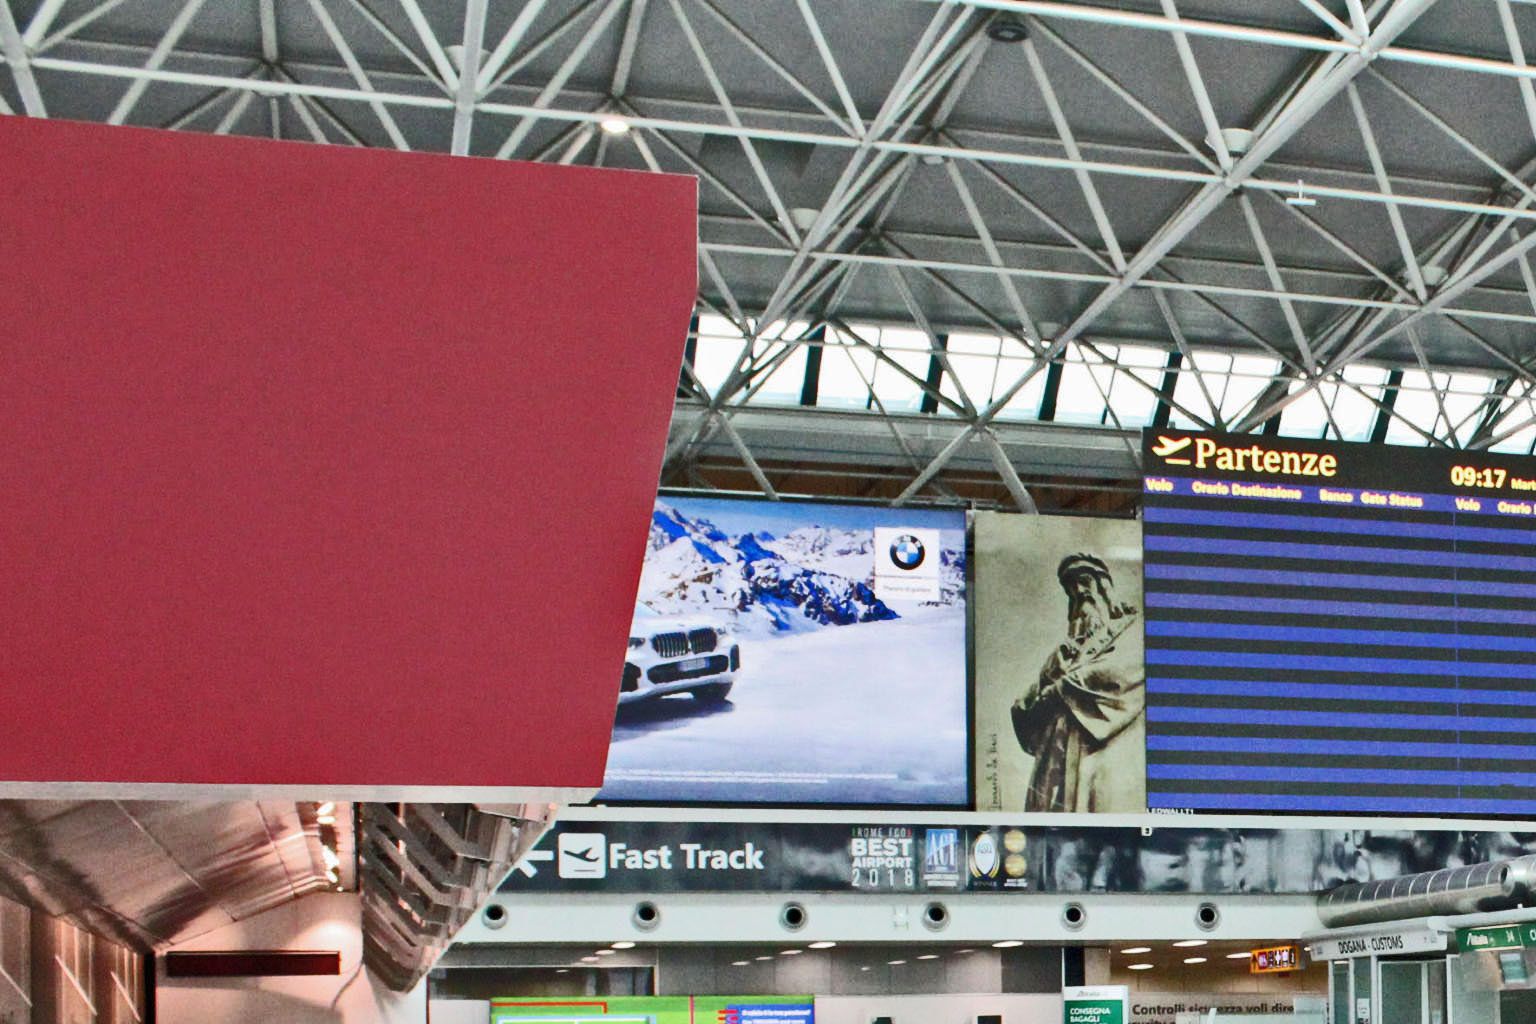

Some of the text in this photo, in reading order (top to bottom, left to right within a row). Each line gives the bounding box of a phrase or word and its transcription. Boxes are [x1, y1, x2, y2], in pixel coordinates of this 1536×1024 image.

[1195, 438, 1337, 476] Partenze
[1451, 466, 1507, 488] 09:17
[1146, 478, 1424, 508] Volo Orario Destinazione Banco Gate Status
[1456, 498, 1481, 512] Volo
[1497, 501, 1532, 515] Orario
[609, 842, 765, 870] Fast Track
[851, 838, 912, 857] BEST
[851, 856, 912, 869] AIRPORT
[851, 868, 913, 887] 2018
[1338, 938, 1367, 954] DOGANA
[1370, 936, 1404, 952] CUSTOMS
[1070, 1007, 1111, 1016] CONSEGNA
[1132, 1003, 1185, 1016] Controlli
[1246, 1003, 1268, 1014] voli
[1070, 1015, 1100, 1023] BAGAGLI
